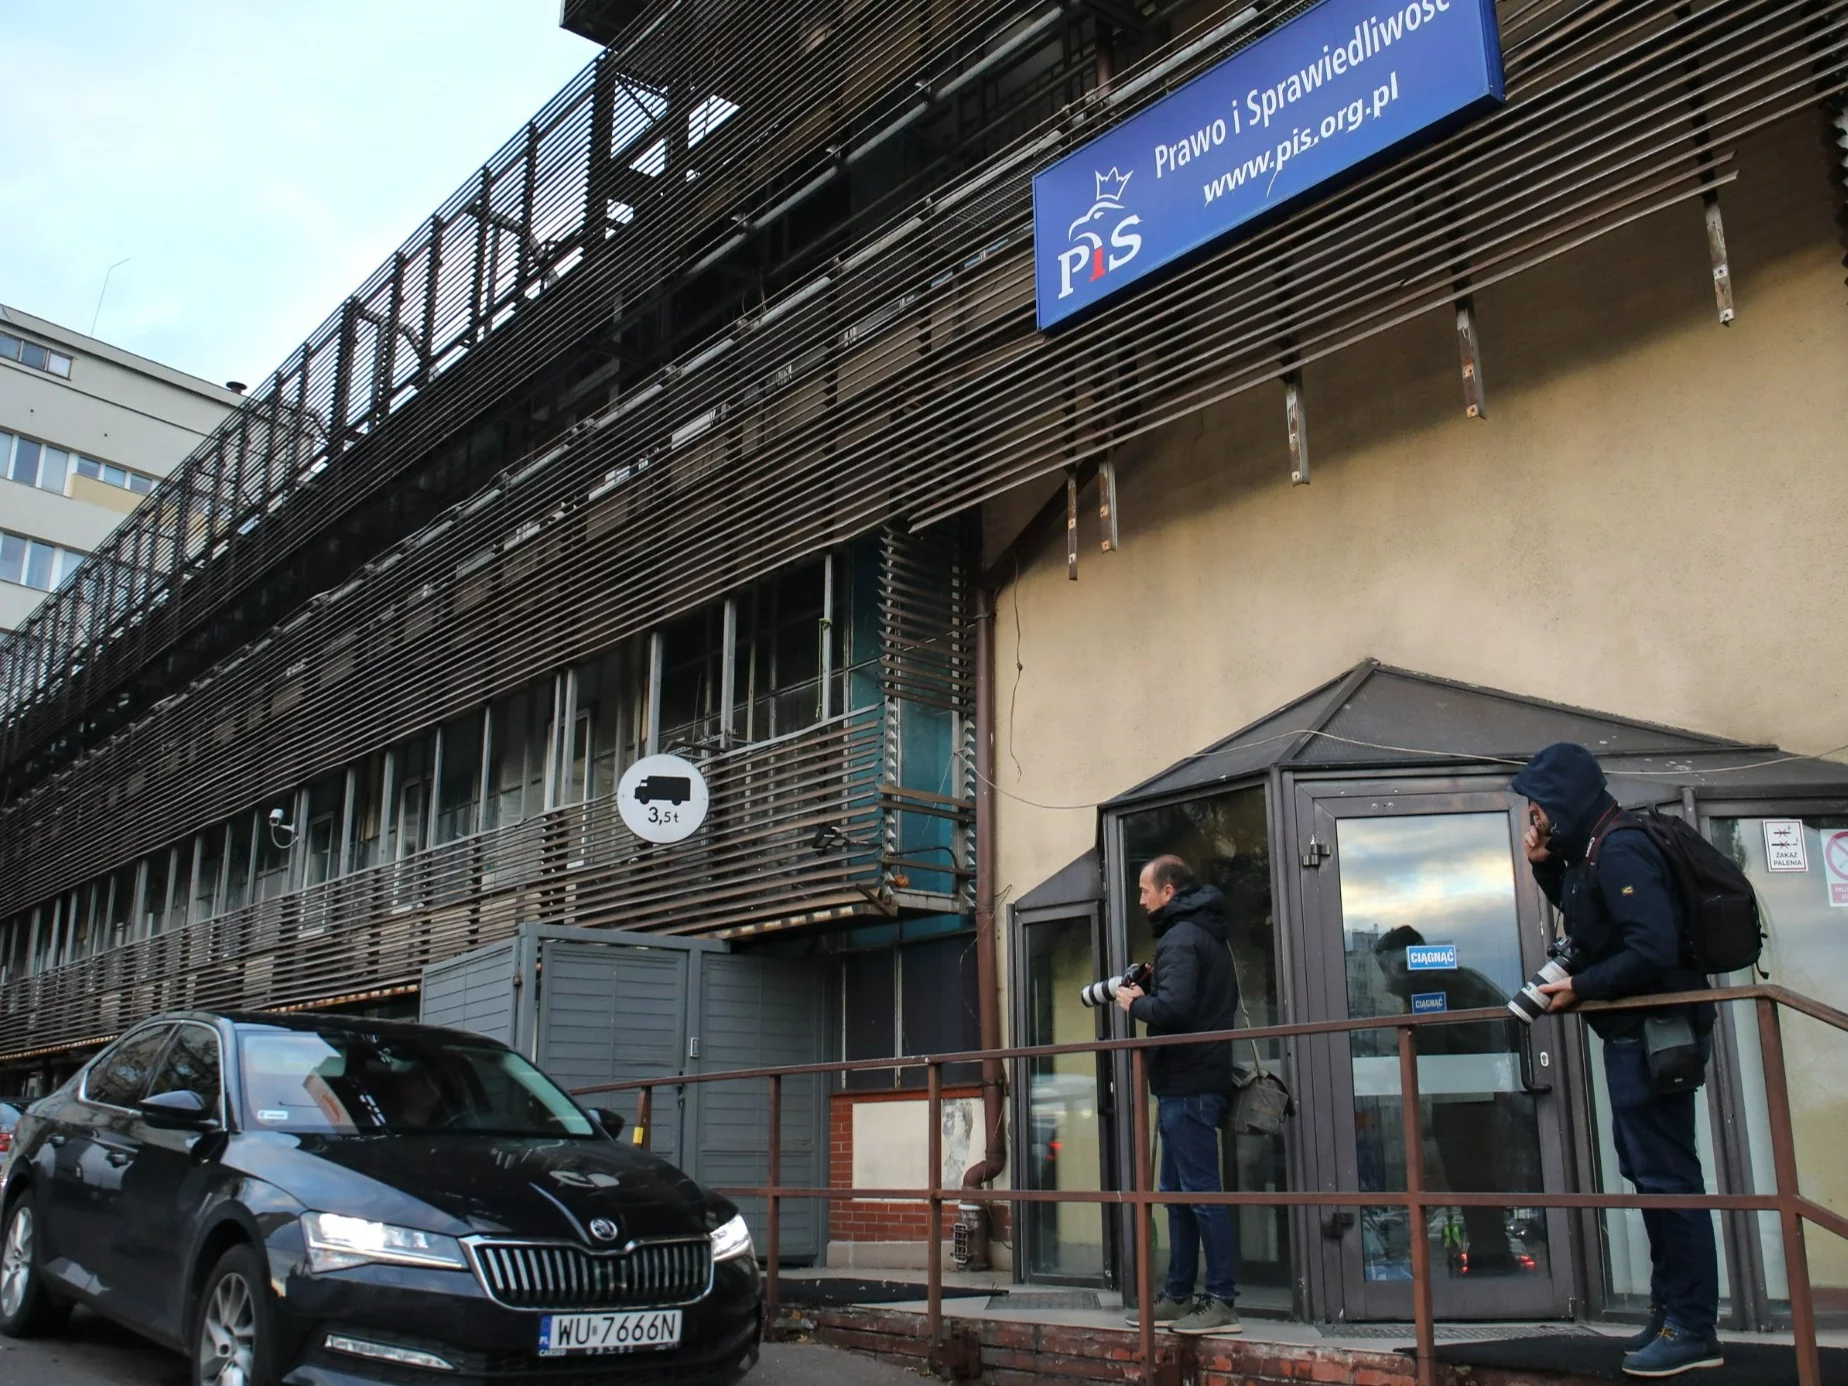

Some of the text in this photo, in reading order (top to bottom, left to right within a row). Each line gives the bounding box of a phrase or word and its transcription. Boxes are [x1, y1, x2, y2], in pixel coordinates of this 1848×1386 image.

[1154, 0, 1450, 179] Prawo i Sprawiedliwo
[1203, 71, 1399, 204] www.pis.org.pl
[1057, 213, 1143, 300] PiS
[1411, 949, 1454, 965] CIĄGNĄĆ
[1415, 997, 1443, 1009] CIĄGNĄĆ
[558, 1312, 677, 1346] WU 7666N
